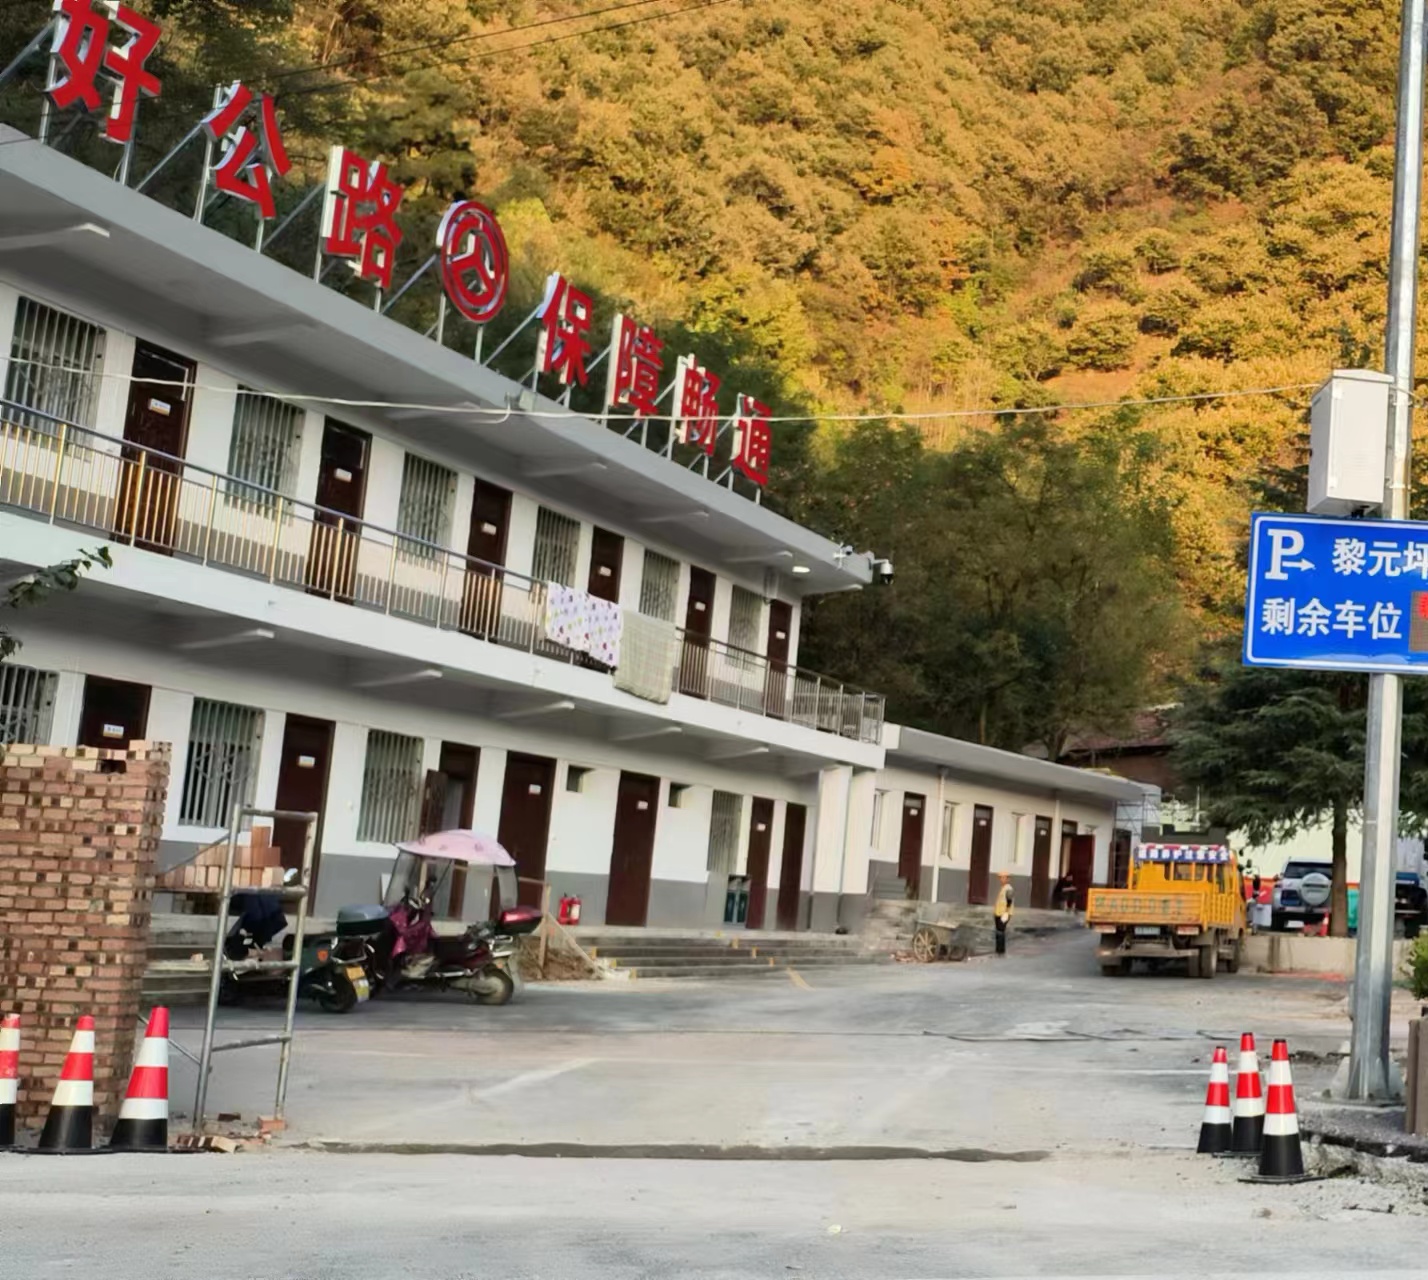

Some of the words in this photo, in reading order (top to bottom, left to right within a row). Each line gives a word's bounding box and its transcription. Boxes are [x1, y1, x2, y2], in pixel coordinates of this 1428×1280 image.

[50, 0, 402, 288] 好公路
[537, 272, 772, 486] 保障畅通
[1265, 528, 1304, 581] P
[1261, 597, 1402, 639] 剩余车位
